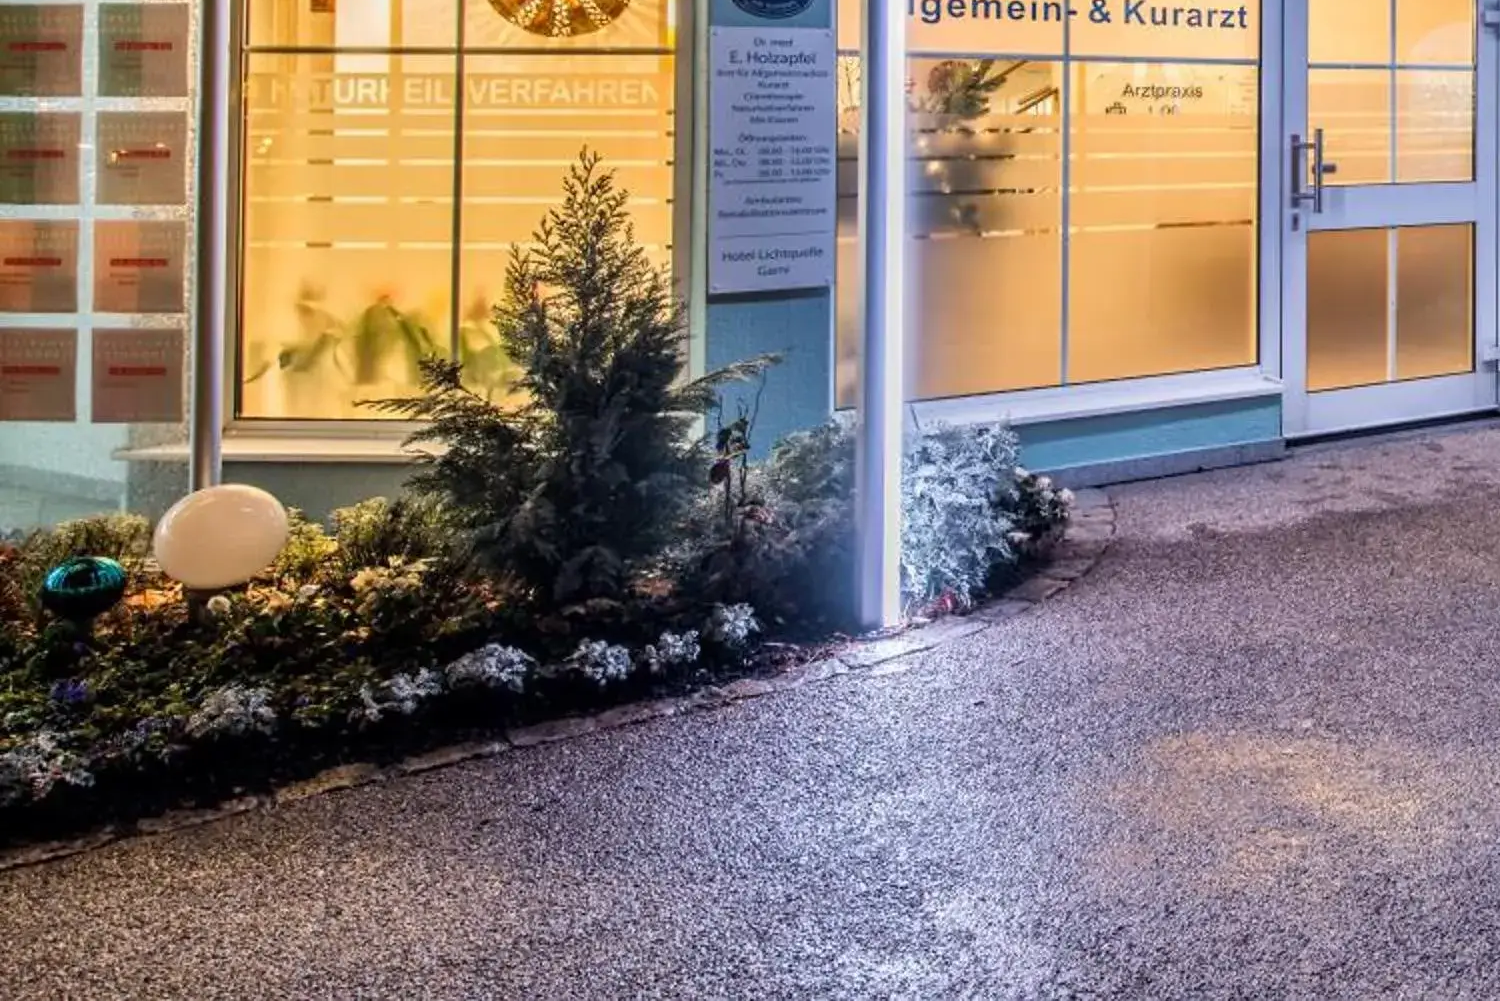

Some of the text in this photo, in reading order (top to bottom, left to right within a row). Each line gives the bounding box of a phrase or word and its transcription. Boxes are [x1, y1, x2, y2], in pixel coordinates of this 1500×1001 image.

[747, 50, 817, 66] Holzapfel
[1122, 83, 1203, 100] Arztpraxis
[722, 249, 755, 262] Hotel
